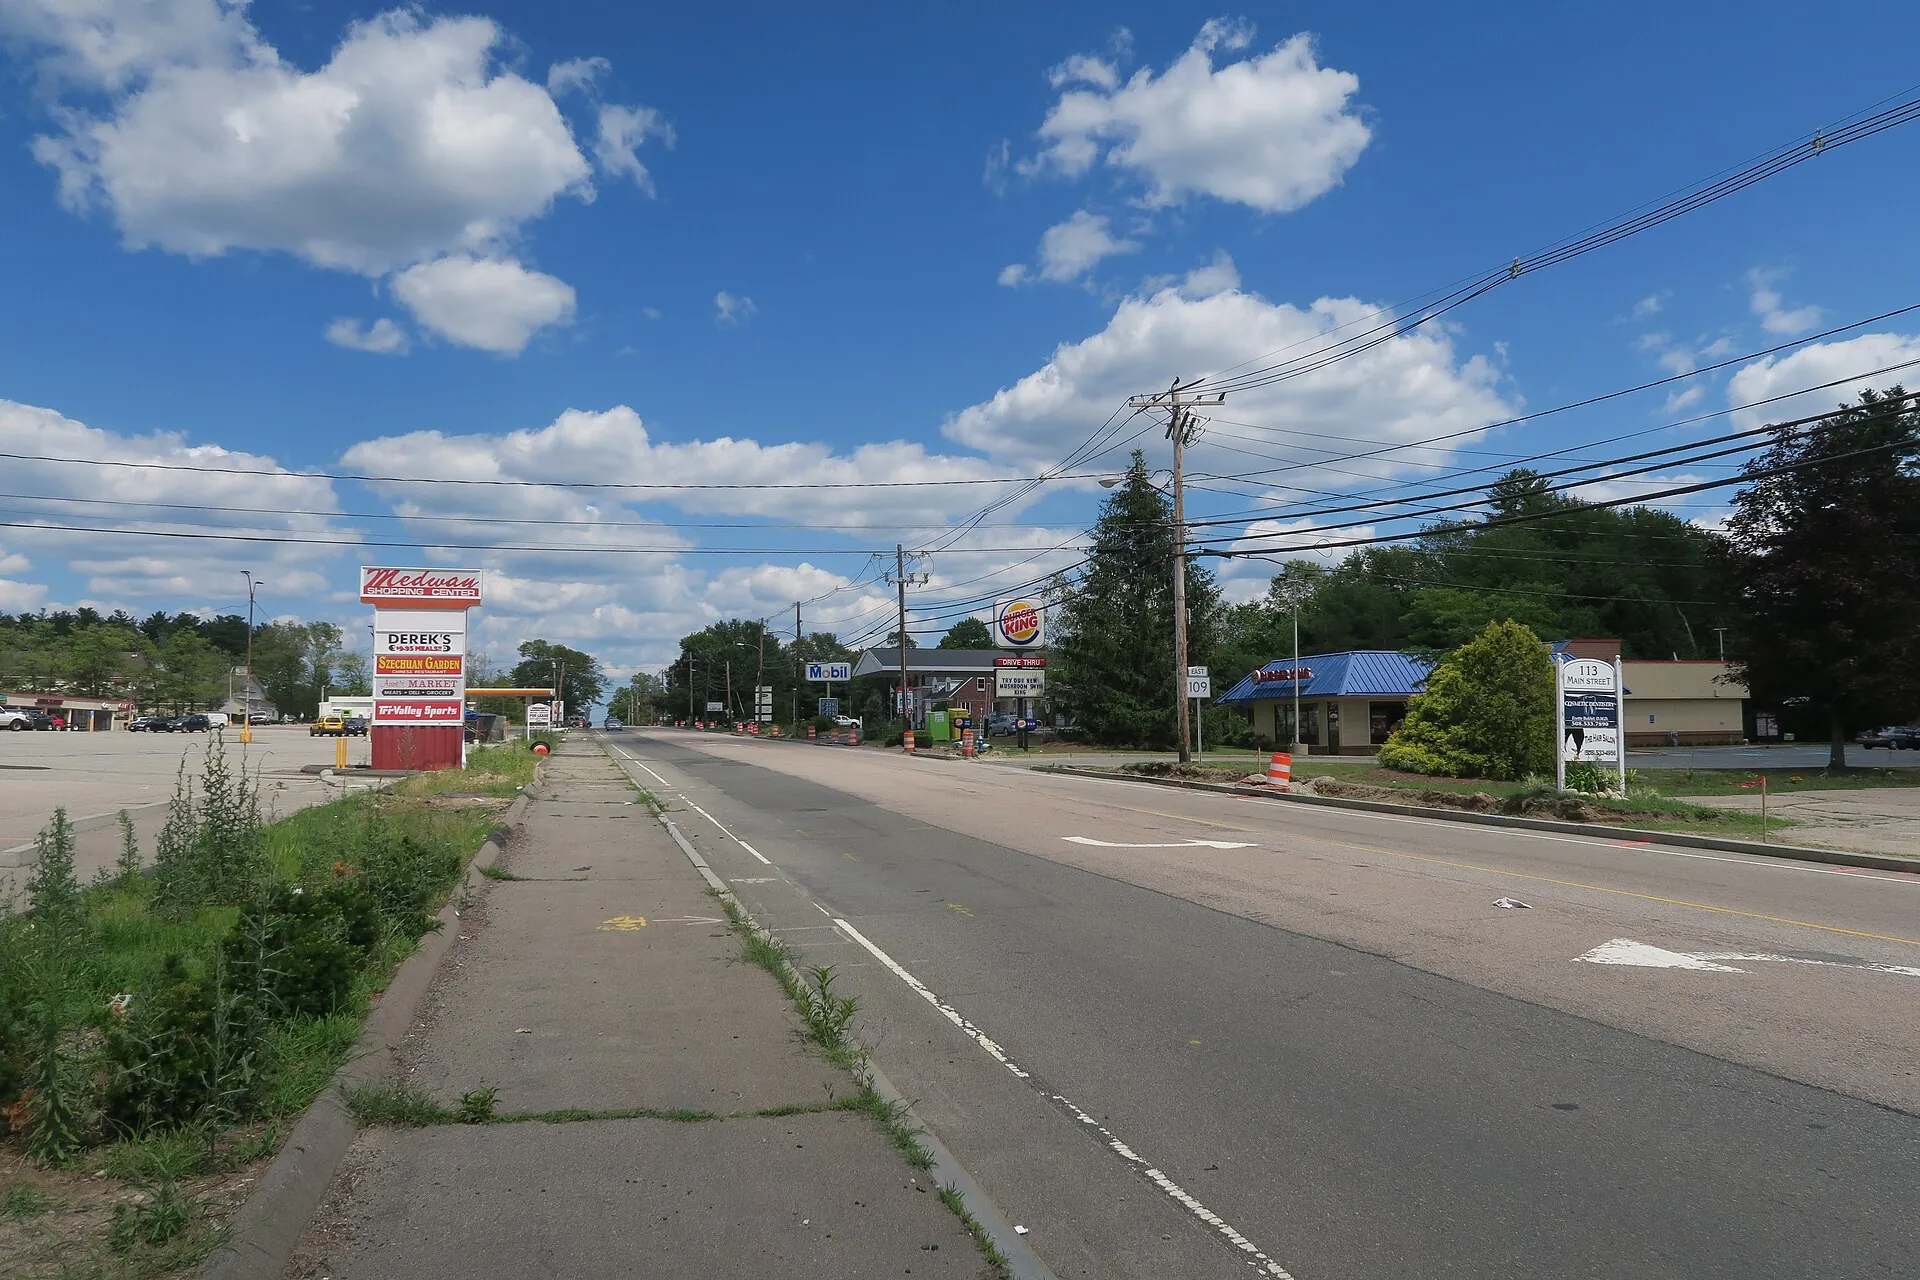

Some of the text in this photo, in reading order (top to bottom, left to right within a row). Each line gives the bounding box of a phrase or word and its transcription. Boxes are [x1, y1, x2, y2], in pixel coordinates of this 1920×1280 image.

[364, 569, 479, 588] Medway
[1005, 616, 1038, 636] KING
[388, 634, 451, 644] DEREK'S
[425, 656, 460, 669] GARDEN
[810, 666, 847, 678] Mobil
[1579, 666, 1598, 676] 113
[1189, 682, 1207, 693] 109
[424, 705, 457, 718] Sports
